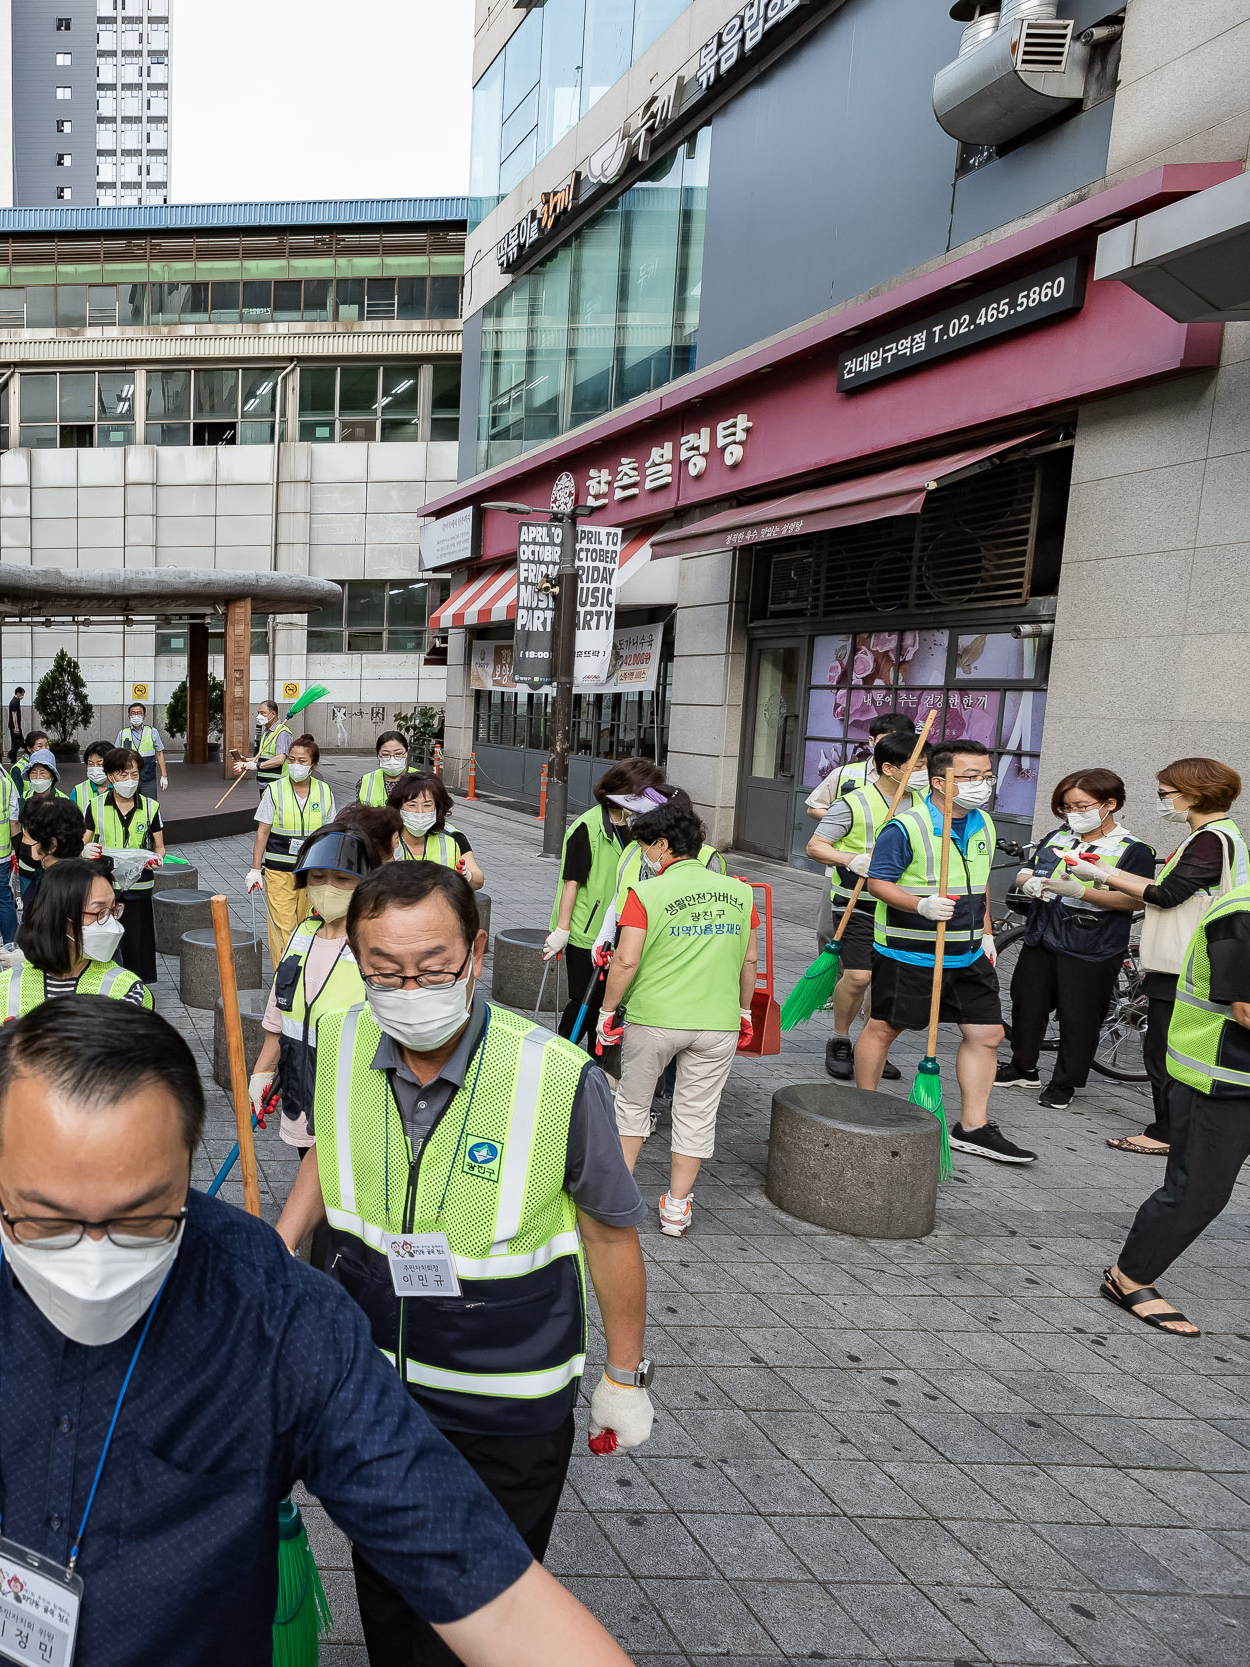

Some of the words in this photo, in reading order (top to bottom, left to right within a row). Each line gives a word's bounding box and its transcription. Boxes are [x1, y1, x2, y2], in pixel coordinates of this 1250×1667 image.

[496, 210, 539, 268] 떡볶이로
[842, 329, 927, 380] 건대입구역점
[932, 275, 1066, 345] T.02.465.5860
[586, 413, 753, 508] 한촌설렁탕
[519, 525, 550, 543] APRIL
[576, 529, 603, 546] PRIL
[605, 532, 618, 547] TO
[759, 525, 780, 539] 맛있는
[781, 520, 803, 534] 설렁탕
[516, 608, 555, 632] PART
[617, 633, 654, 651] 도가니수육
[524, 650, 550, 658] 18:00
[863, 694, 872, 706] 내
[897, 694, 919, 708] 주는
[664, 891, 744, 917] 생활안전거버넌스
[690, 909, 726, 922] 광진구
[465, 1161, 496, 1178] 광진구
[403, 1264, 439, 1273] 주민자치회장
[39, 1627, 55, 1641] 위원
